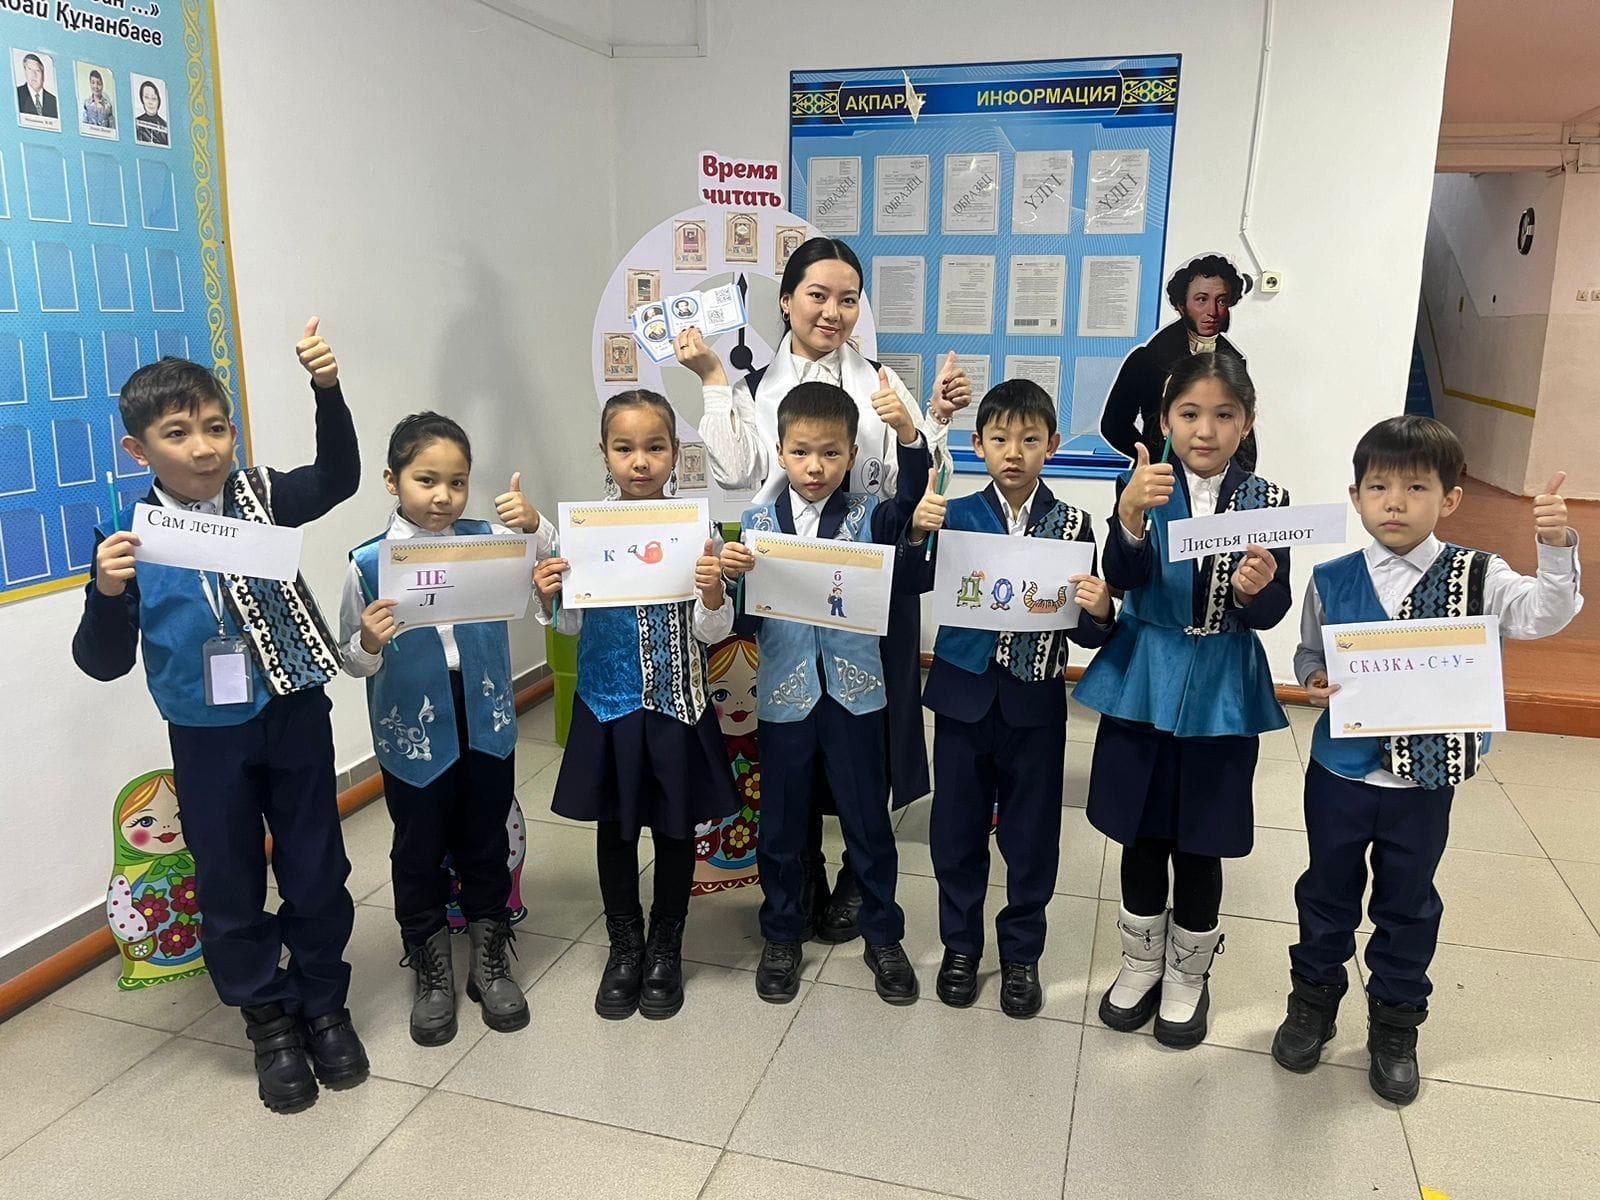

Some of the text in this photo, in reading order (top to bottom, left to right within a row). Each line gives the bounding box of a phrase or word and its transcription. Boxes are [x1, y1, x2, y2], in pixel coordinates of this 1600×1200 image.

[56, 1, 163, 46] Құнанбаев
[976, 85, 1118, 107] ИНФОРМАЦИЯ
[702, 155, 777, 182] Время
[702, 188, 782, 206] читать
[817, 176, 857, 215] ОБРАЗЕЦ
[883, 175, 924, 214] ОБРАЗЕЦ
[952, 173, 994, 214] ОБРАЗЕЦ
[147, 509, 239, 538] Сам летит
[1180, 528, 1314, 553] Листья падают
[416, 570, 448, 586] ПЕ
